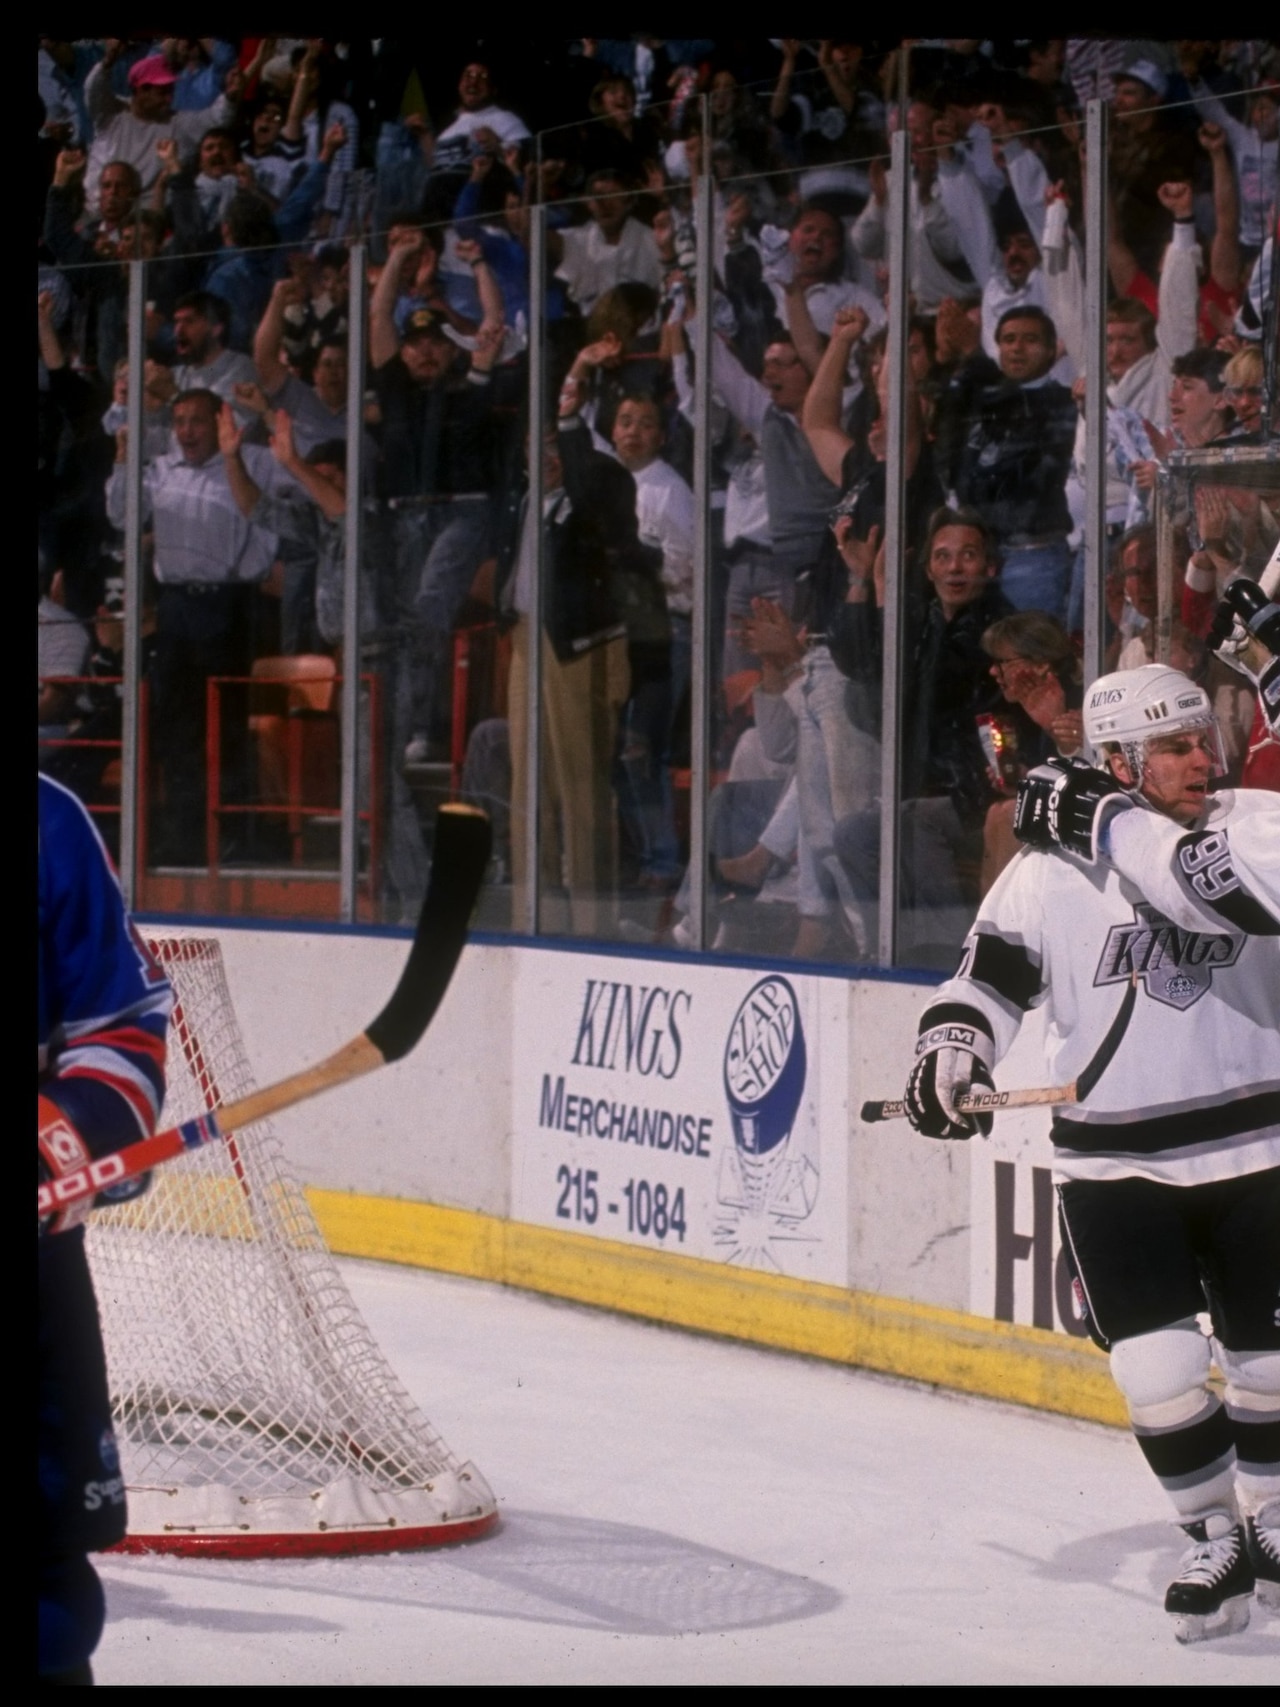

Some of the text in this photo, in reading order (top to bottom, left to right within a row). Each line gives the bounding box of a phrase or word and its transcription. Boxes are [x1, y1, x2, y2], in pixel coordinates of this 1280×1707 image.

[1090, 687, 1126, 709] KINGS
[1179, 828, 1239, 901] 99
[570, 979, 693, 1080] KINGS
